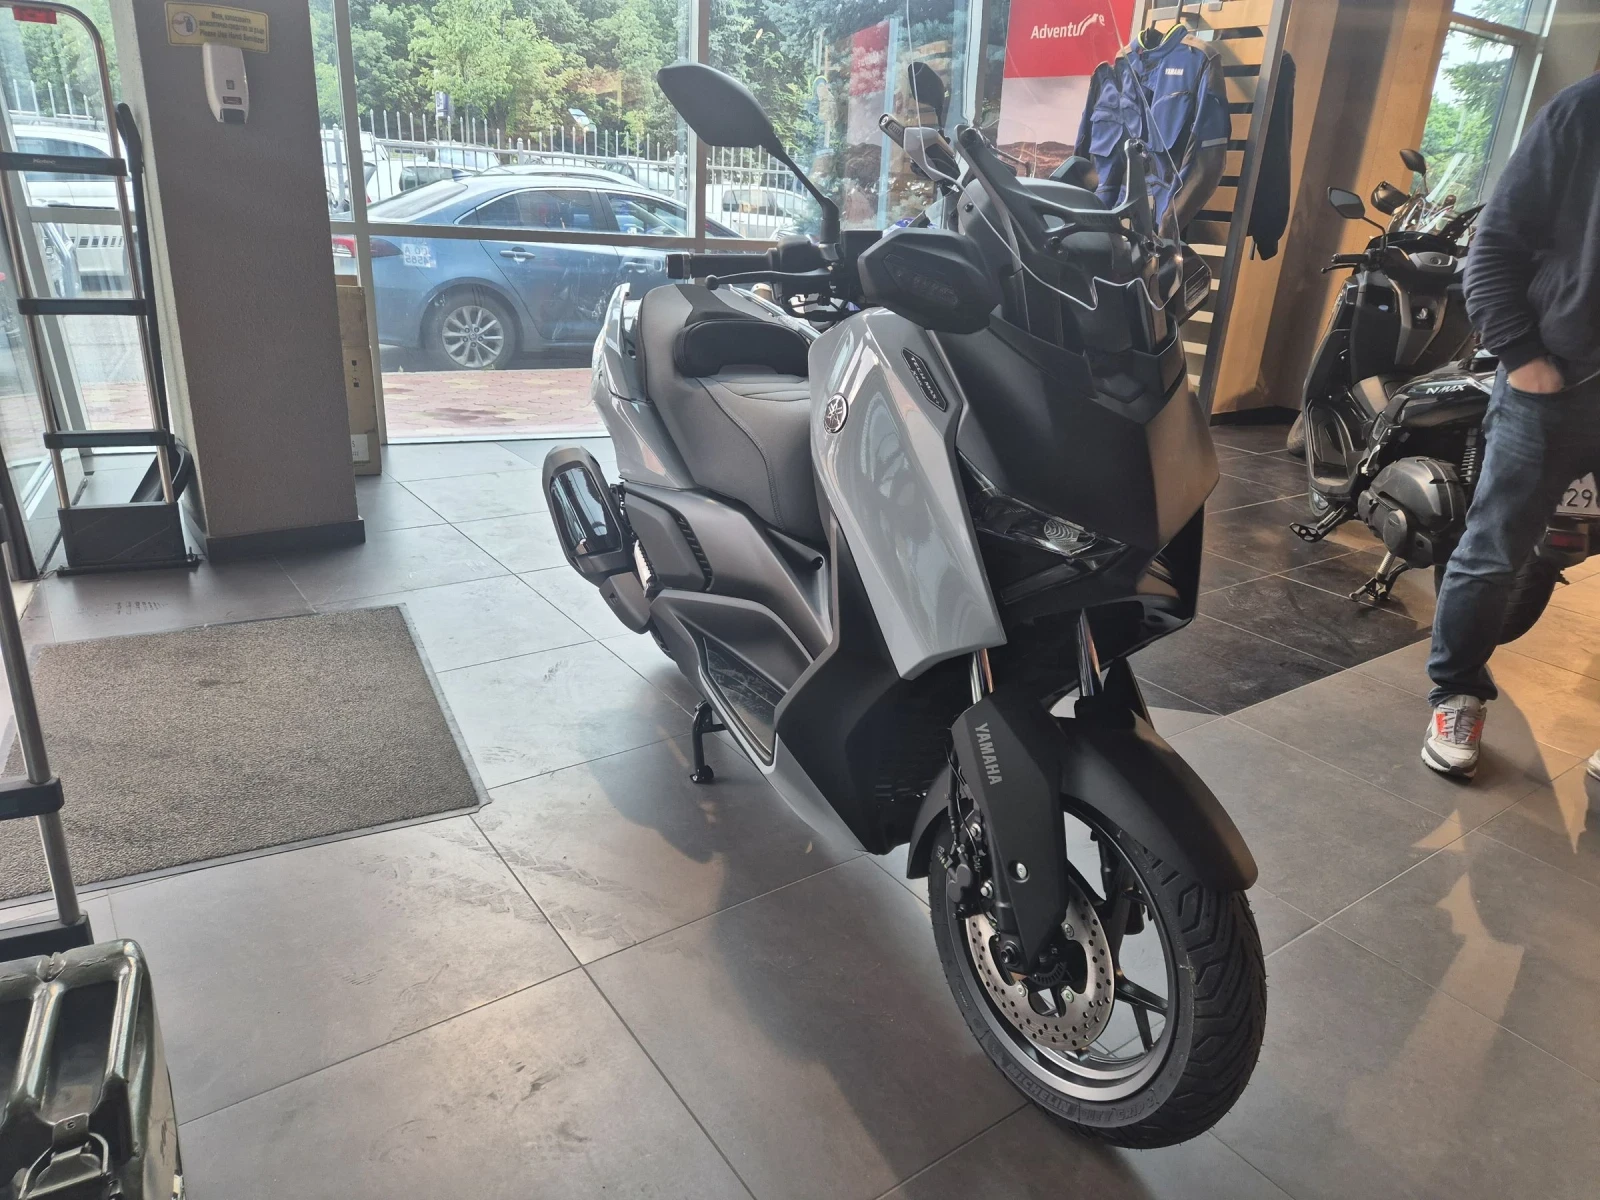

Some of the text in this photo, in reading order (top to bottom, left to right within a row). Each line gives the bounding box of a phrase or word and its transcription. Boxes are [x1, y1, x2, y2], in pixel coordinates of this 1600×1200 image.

[1030, 13, 1106, 40] Adventure
[1164, 67, 1184, 76] YAMAHA
[910, 356, 926, 380] TECH
[974, 721, 1003, 786] YAMAHA
[1006, 1063, 1072, 1113] MICHELIN
